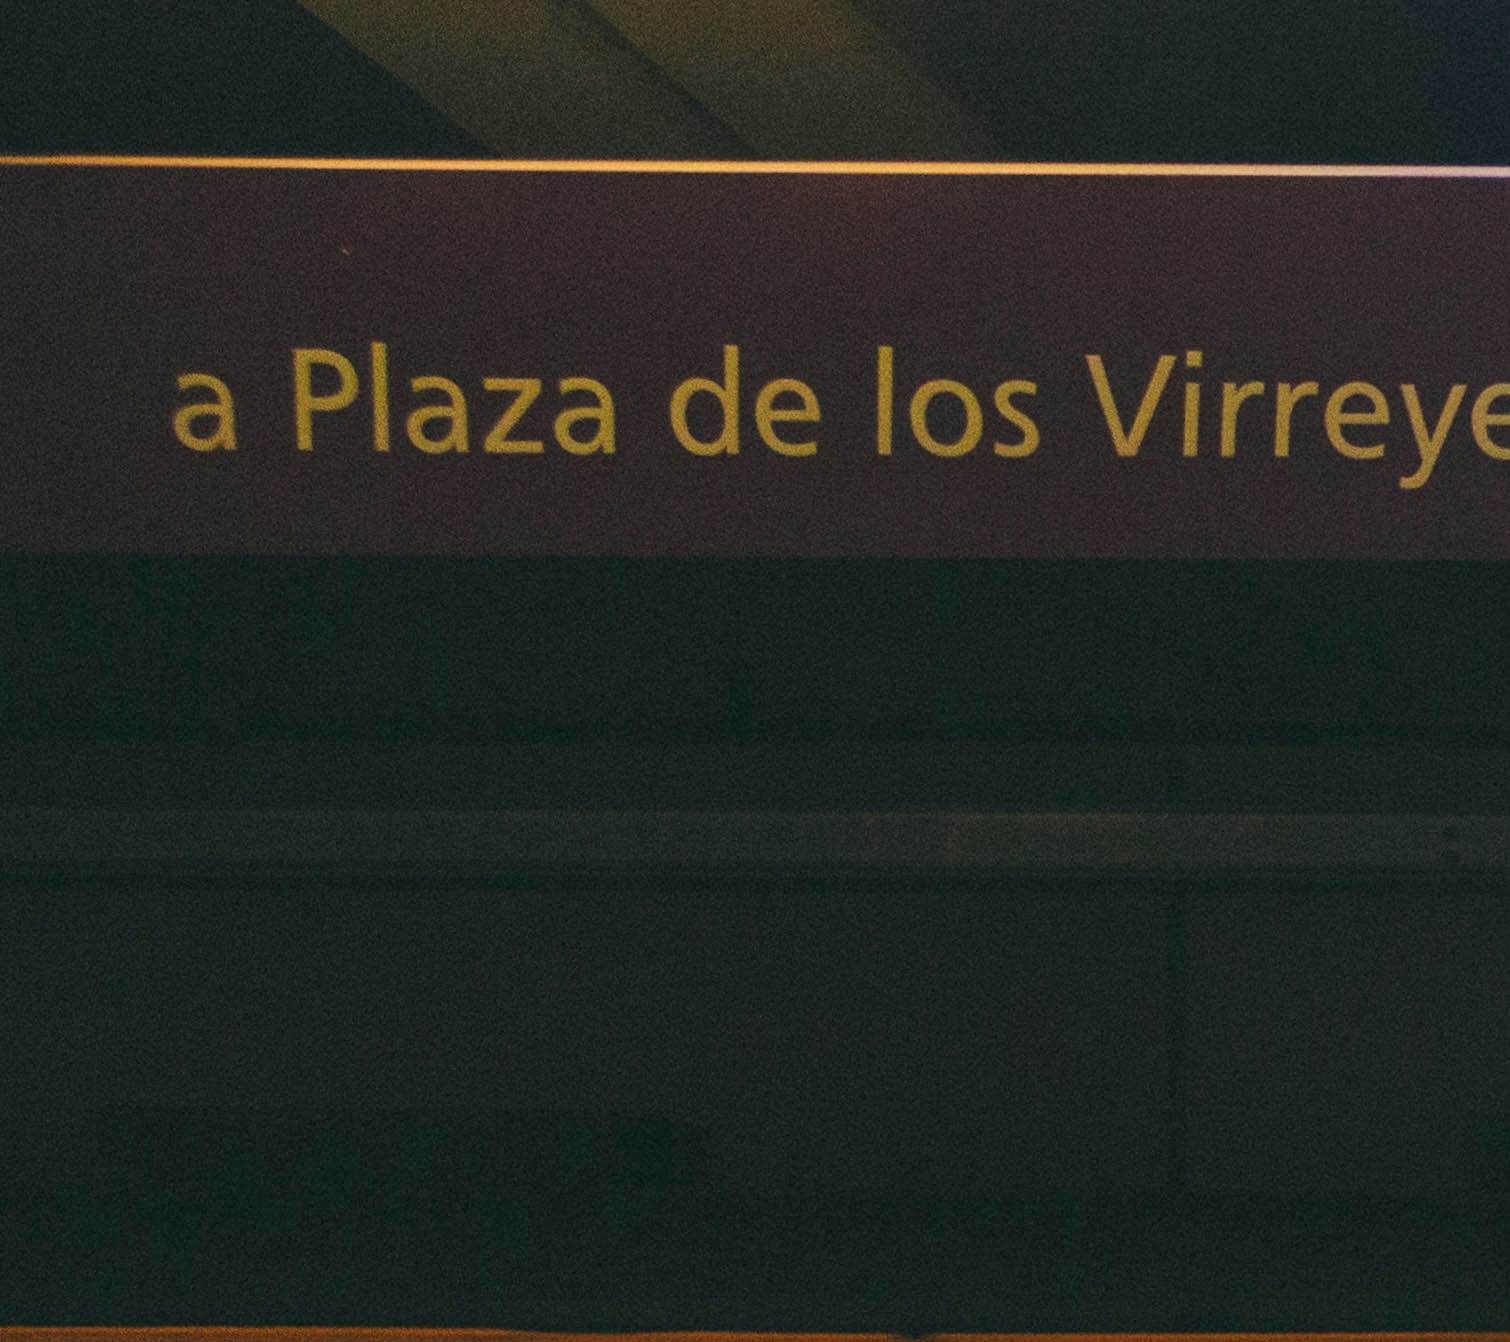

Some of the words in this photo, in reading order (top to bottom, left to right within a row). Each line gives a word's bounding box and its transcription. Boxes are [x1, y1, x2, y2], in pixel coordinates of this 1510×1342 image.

[172, 373, 239, 452] a
[291, 341, 617, 455] Plaza
[669, 345, 821, 457] de
[876, 347, 1040, 458] los
